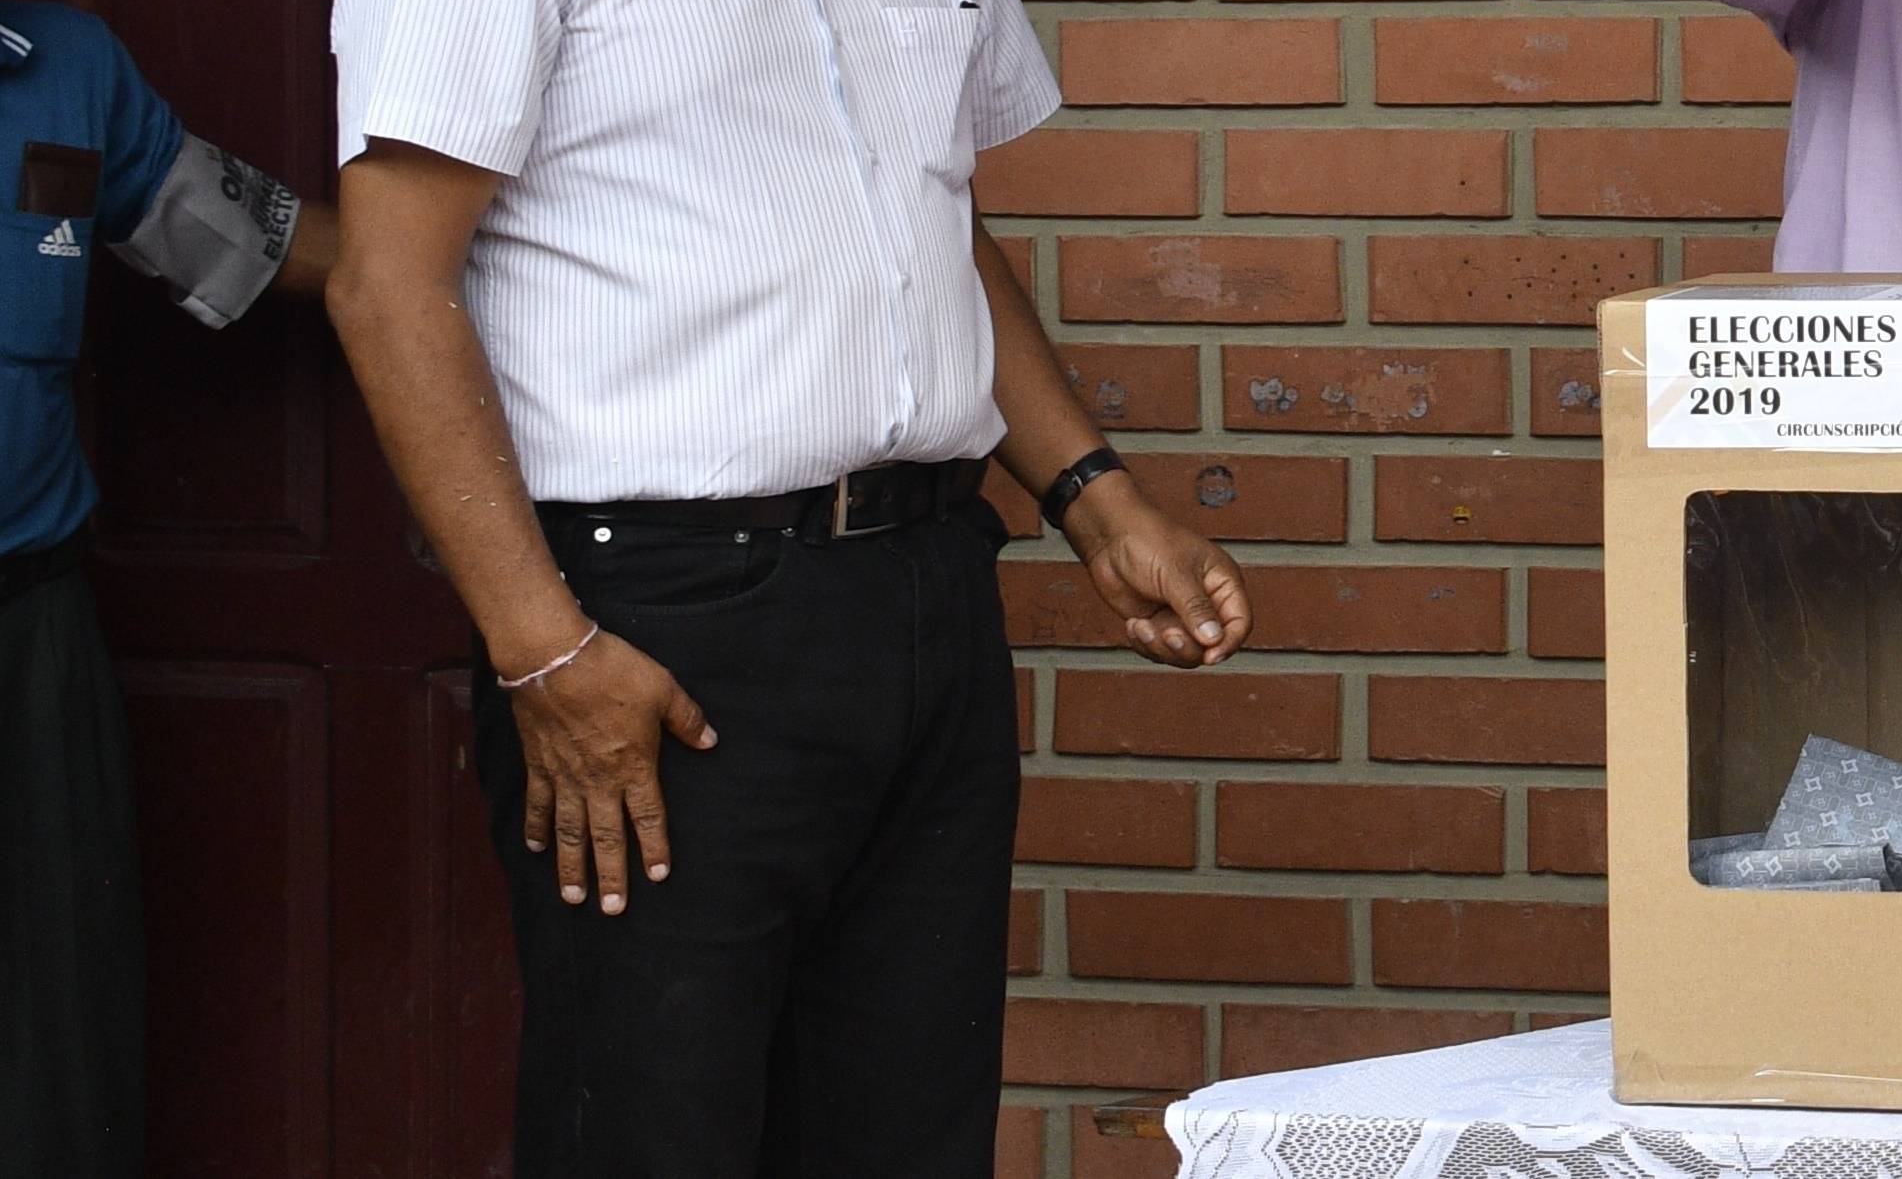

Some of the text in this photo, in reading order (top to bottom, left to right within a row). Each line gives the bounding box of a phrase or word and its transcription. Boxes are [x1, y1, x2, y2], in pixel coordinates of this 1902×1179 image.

[38, 243, 82, 258] adidas
[1689, 314, 1898, 344] ELECCIONES
[1689, 349, 1885, 379] GENERALES
[1689, 387, 1782, 417] 2019
